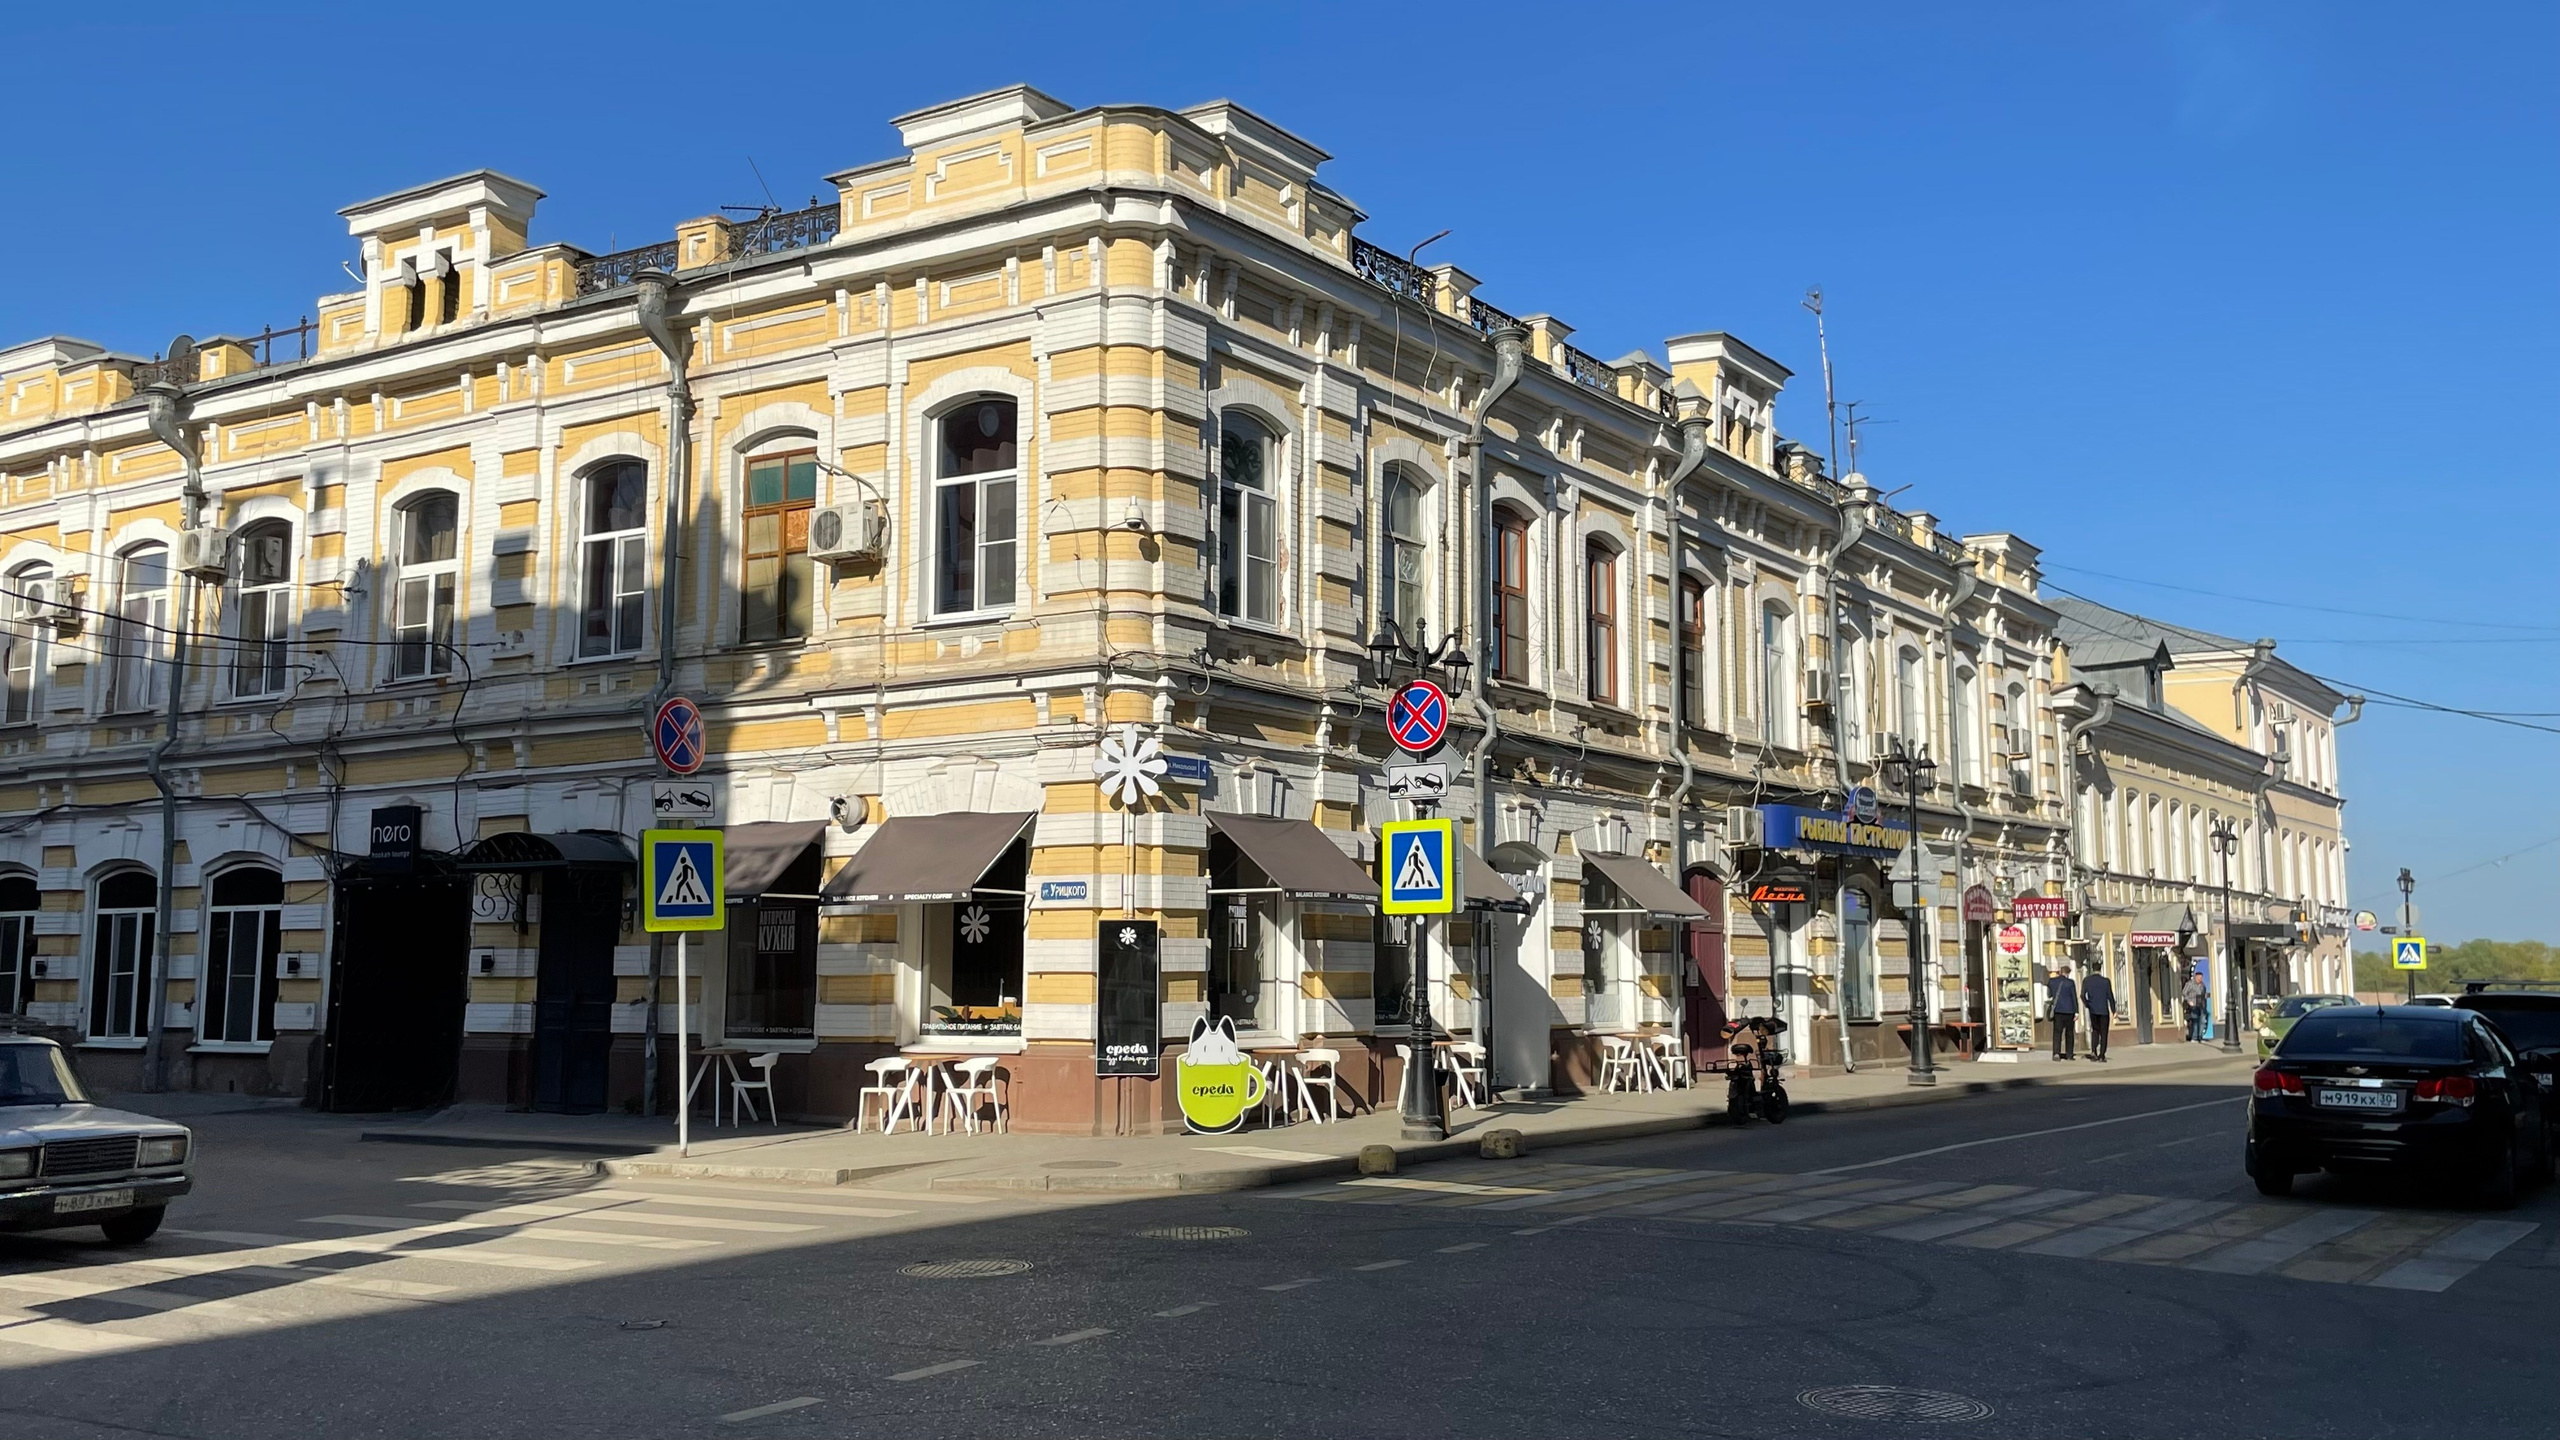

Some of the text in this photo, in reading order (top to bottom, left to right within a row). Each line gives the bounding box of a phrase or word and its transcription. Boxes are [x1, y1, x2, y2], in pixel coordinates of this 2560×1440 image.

[1801, 816, 1847, 844] РЫБНАЯ
[2015, 902, 2066, 911] НАСТОЙКИ
[2015, 910, 2066, 918] НАЛИВКИ
[758, 925, 796, 951] КУХНЯ
[2132, 934, 2175, 944] ПРОДУКТЫ
